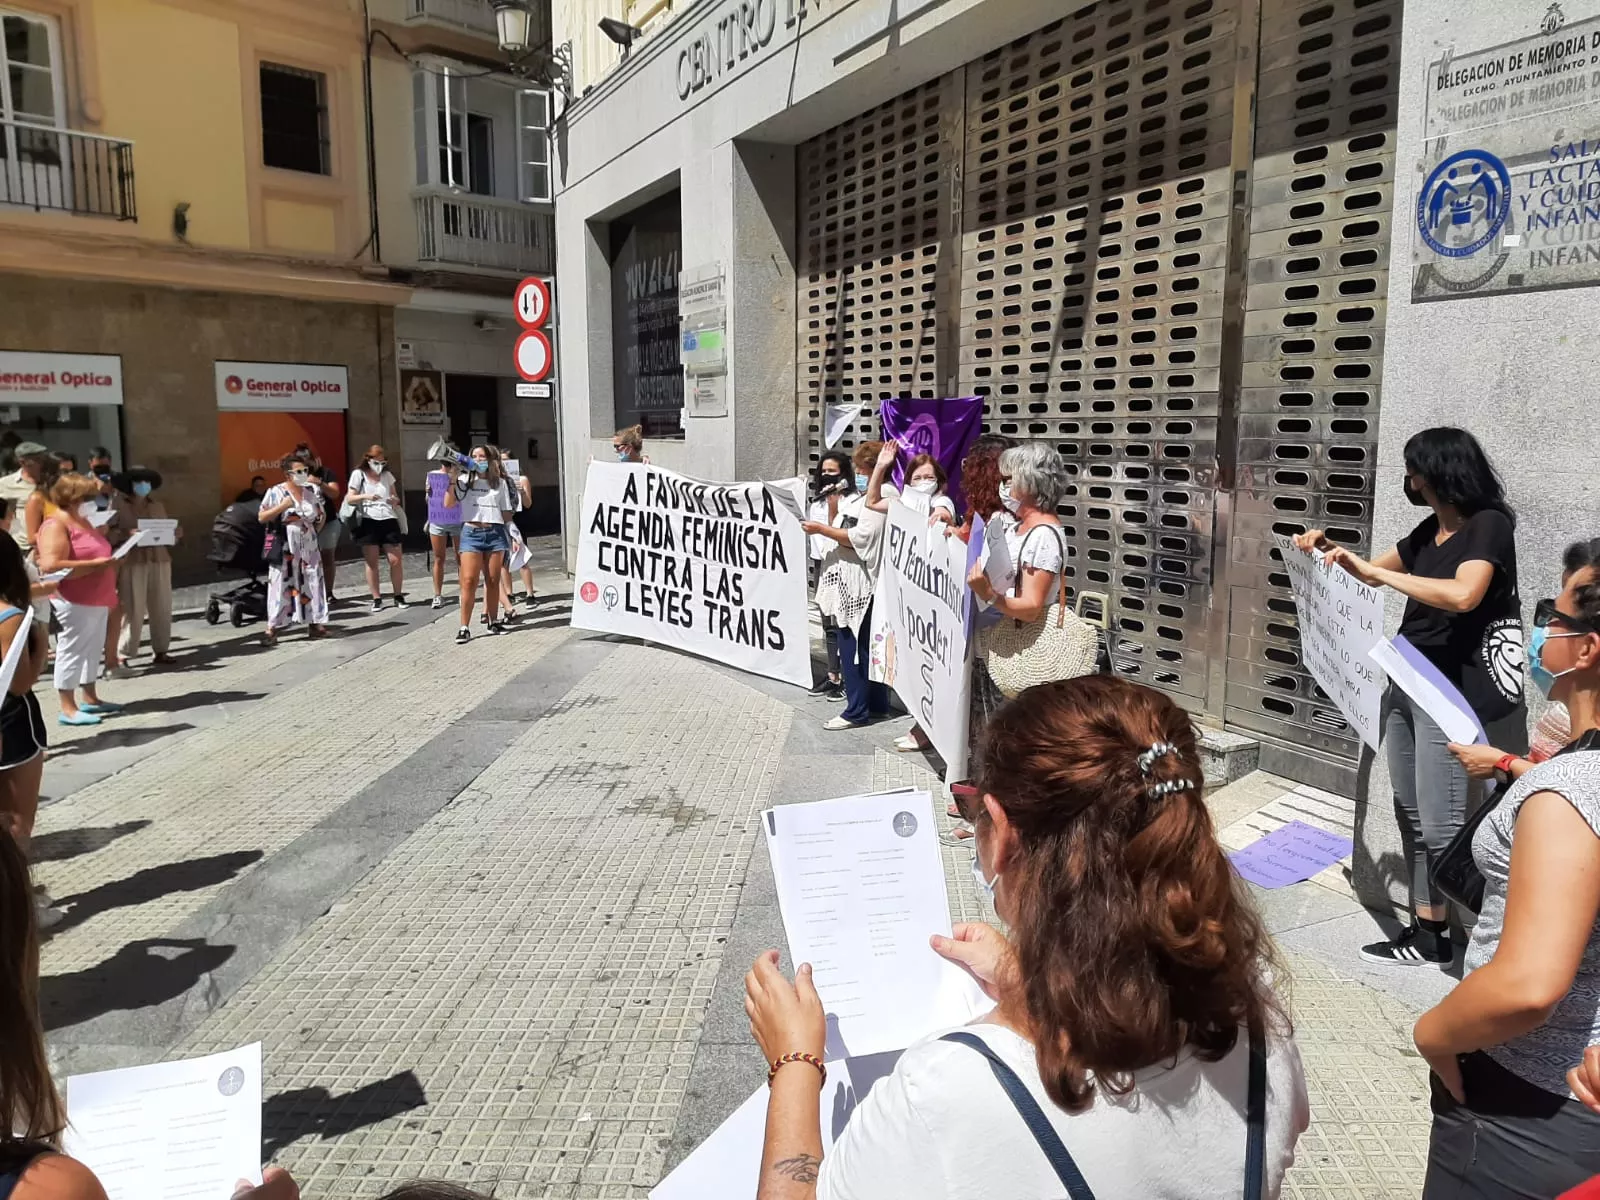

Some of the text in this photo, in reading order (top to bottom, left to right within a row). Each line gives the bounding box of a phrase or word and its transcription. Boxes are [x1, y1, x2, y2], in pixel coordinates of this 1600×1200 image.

[676, 0, 776, 101] CENTRO
[1437, 59, 1505, 91] DELEGACION
[1508, 54, 1524, 72] DE
[1527, 37, 1586, 67] MEMORIA
[1503, 59, 1586, 87] AYUNTAMIENTO
[1529, 158, 1600, 190] LACTA
[1541, 182, 1600, 209] CUID
[1527, 204, 1600, 232] INFAN
[0, 371, 113, 388] eneral Optica
[246, 378, 342, 395] General Optica
[622, 472, 778, 525] A FAVOR DE LA
[590, 502, 675, 552] AGENDA
[890, 523, 905, 571] El
[598, 541, 744, 606] CONTRA LAS
[1335, 569, 1350, 590] SON
[1354, 582, 1377, 604] TAN
[625, 581, 693, 628] LEYES
[704, 600, 785, 651] TRANS
[1337, 599, 1352, 621] QUE
[1360, 615, 1374, 636] LA
[1355, 662, 1373, 683] QUE
